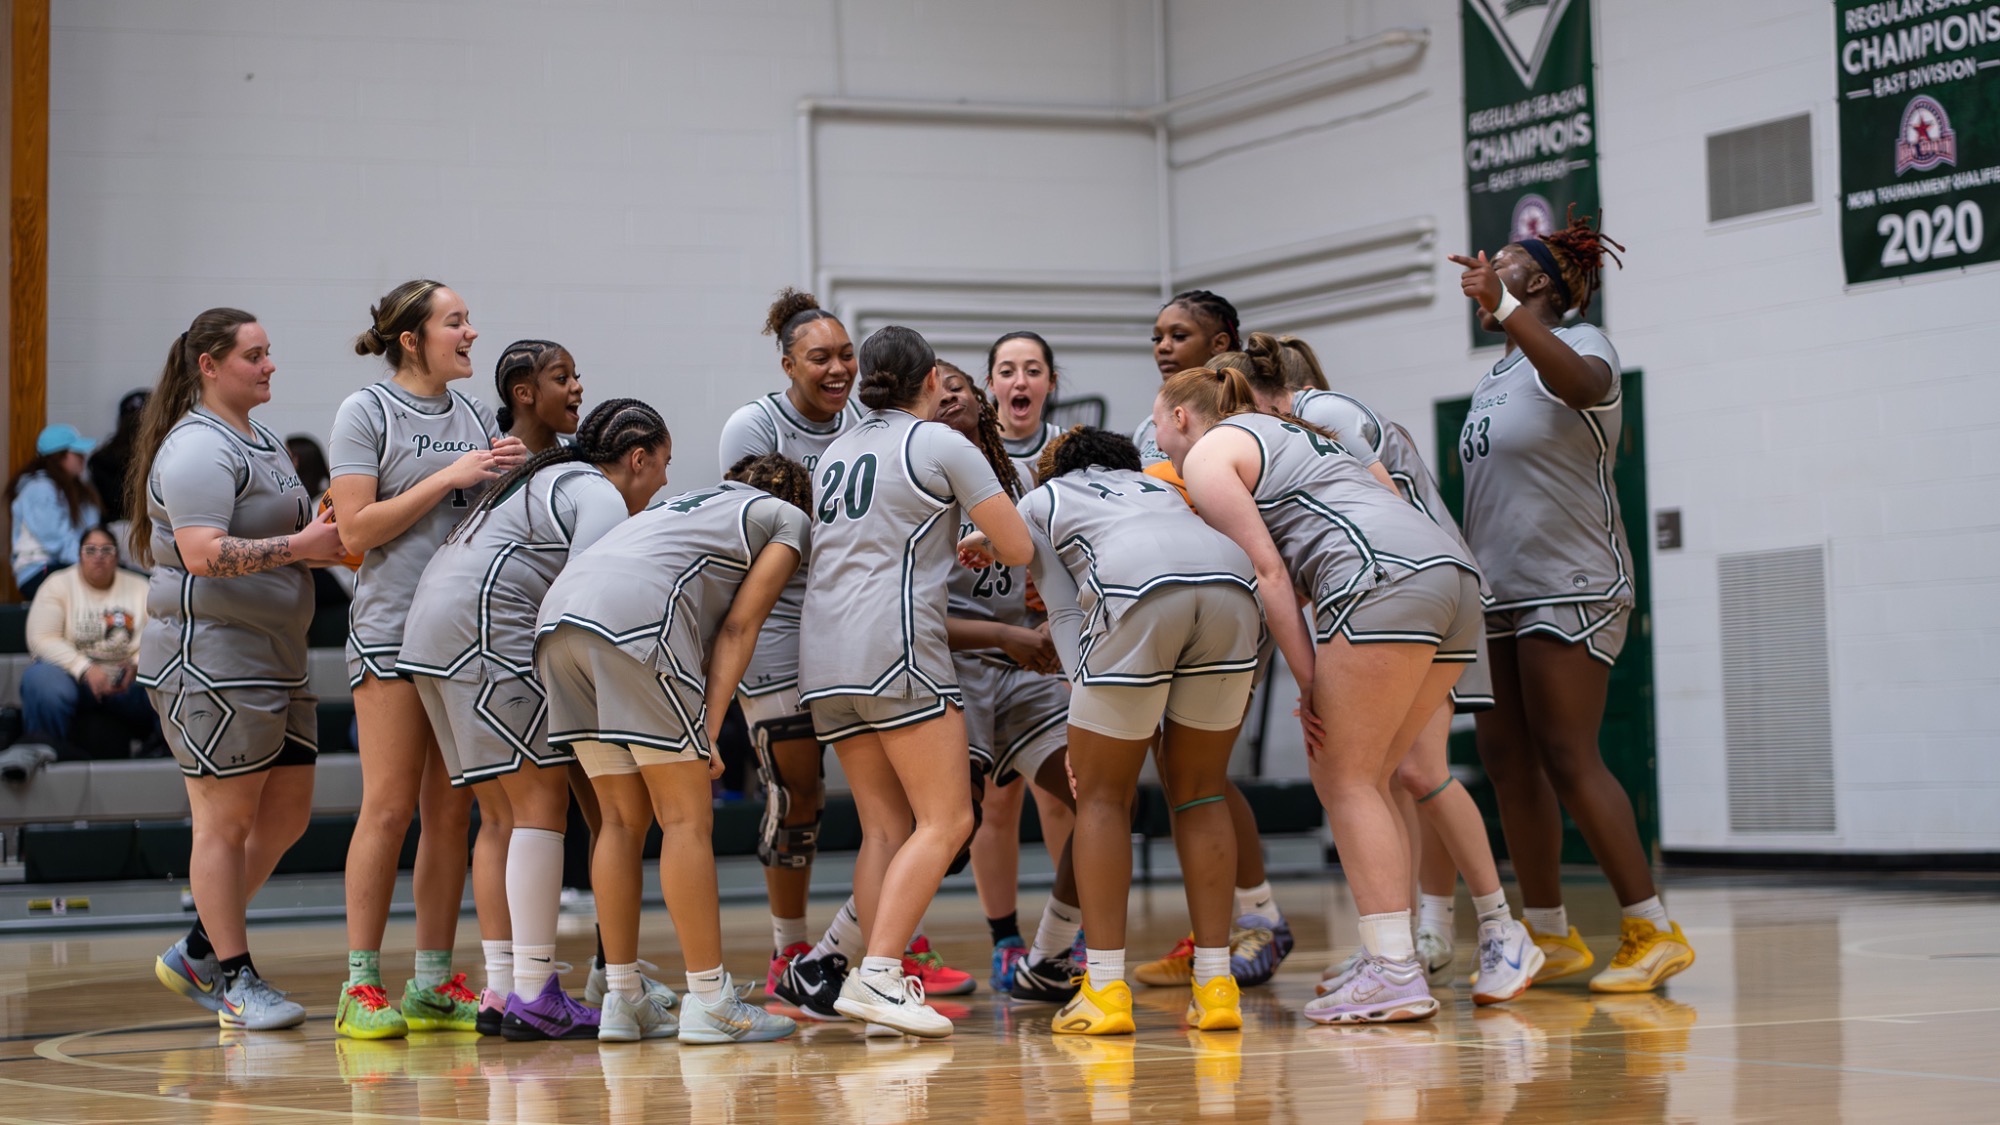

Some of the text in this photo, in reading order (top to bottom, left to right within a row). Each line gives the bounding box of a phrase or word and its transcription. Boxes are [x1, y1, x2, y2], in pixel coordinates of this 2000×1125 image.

[1845, 0, 1924, 33] REGULAR
[1842, 5, 2000, 75] CHAMPIONS
[1873, 56, 1977, 98] EAST DIVISION
[1876, 175, 1952, 204] TOURNAMENT
[1877, 199, 1984, 268] 2020
[1462, 415, 1491, 464] 33
[817, 451, 879, 525] 20
[971, 559, 1013, 598] 23
